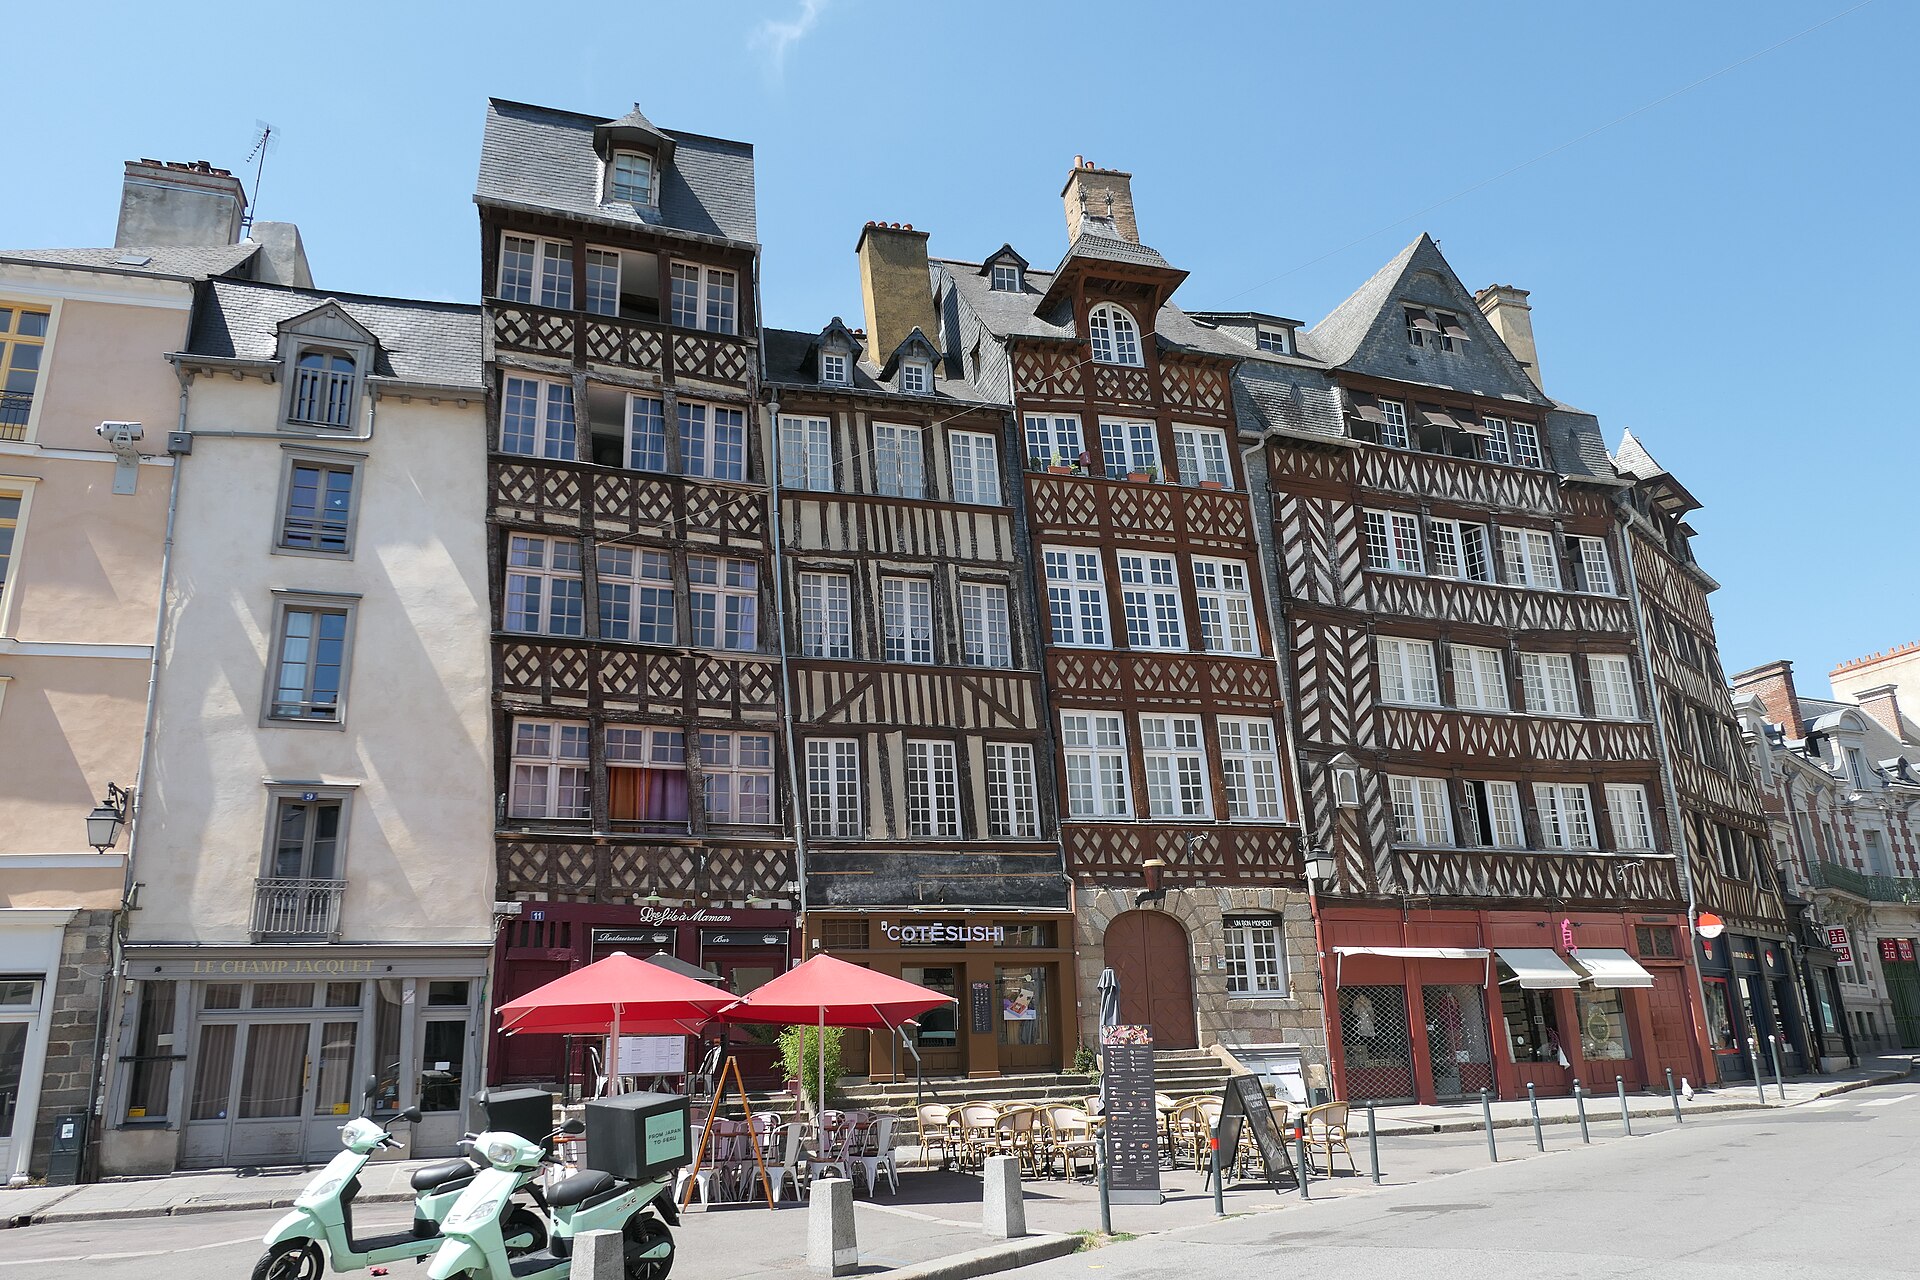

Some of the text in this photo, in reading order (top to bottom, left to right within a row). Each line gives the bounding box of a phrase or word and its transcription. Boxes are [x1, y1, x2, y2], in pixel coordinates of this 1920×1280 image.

[533, 912, 542, 920] 11
[687, 908, 732, 922] Maman
[597, 932, 645, 942] Restaurant
[712, 934, 731, 944] Bar
[193, 959, 375, 975] LE CHAMP JACQUET
[648, 1128, 682, 1140] FROM JAPAN
